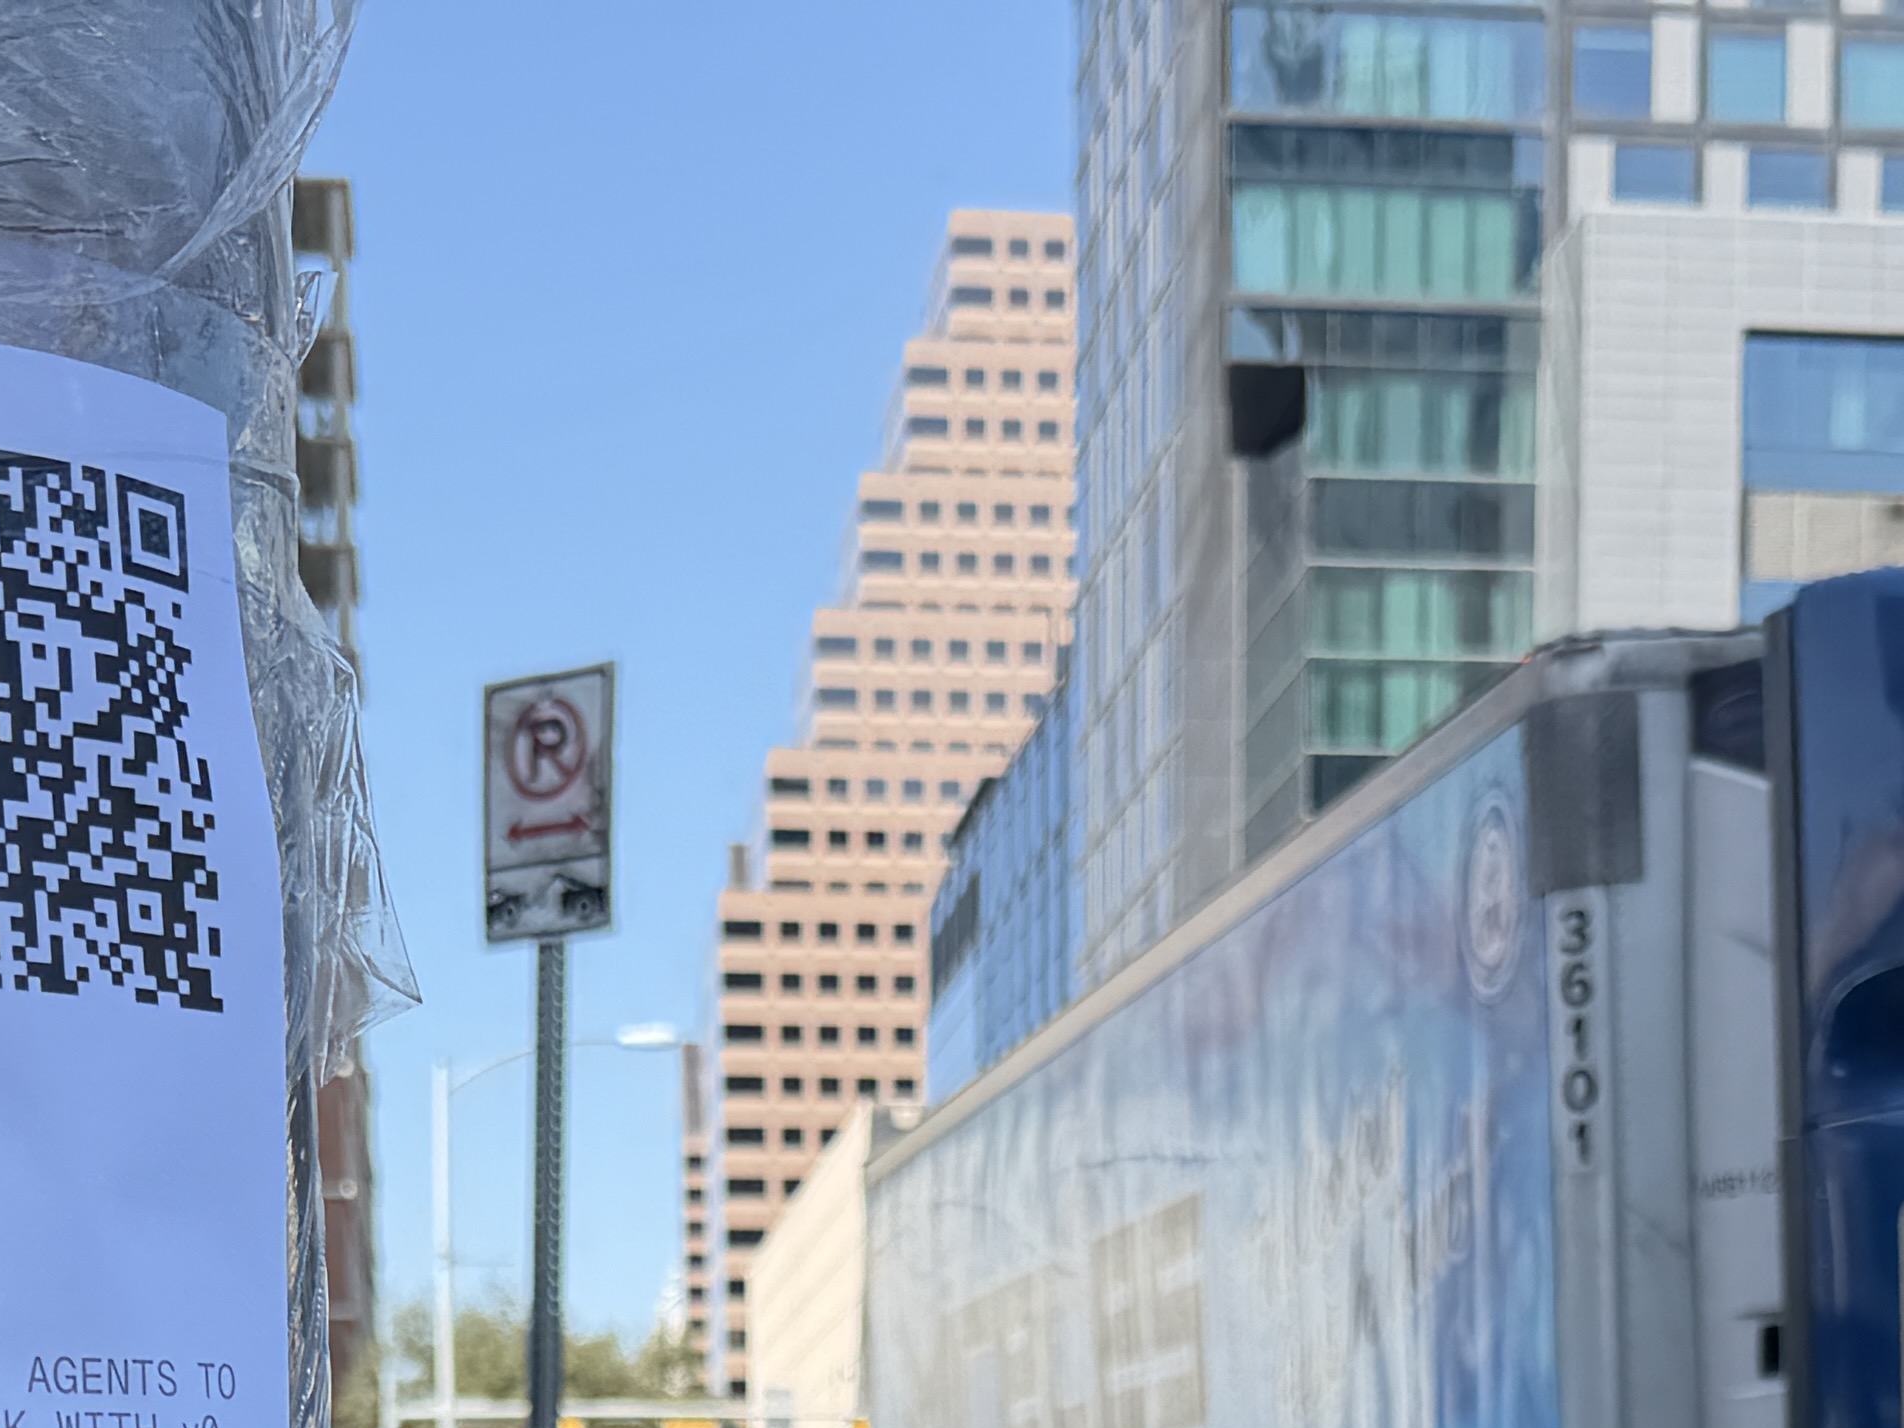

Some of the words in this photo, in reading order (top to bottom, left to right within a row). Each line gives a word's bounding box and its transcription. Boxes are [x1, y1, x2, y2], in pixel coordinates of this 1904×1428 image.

[1559, 909, 1599, 1168] 36101
[28, 1356, 177, 1396] AGENTS
[197, 1363, 235, 1399] TO
